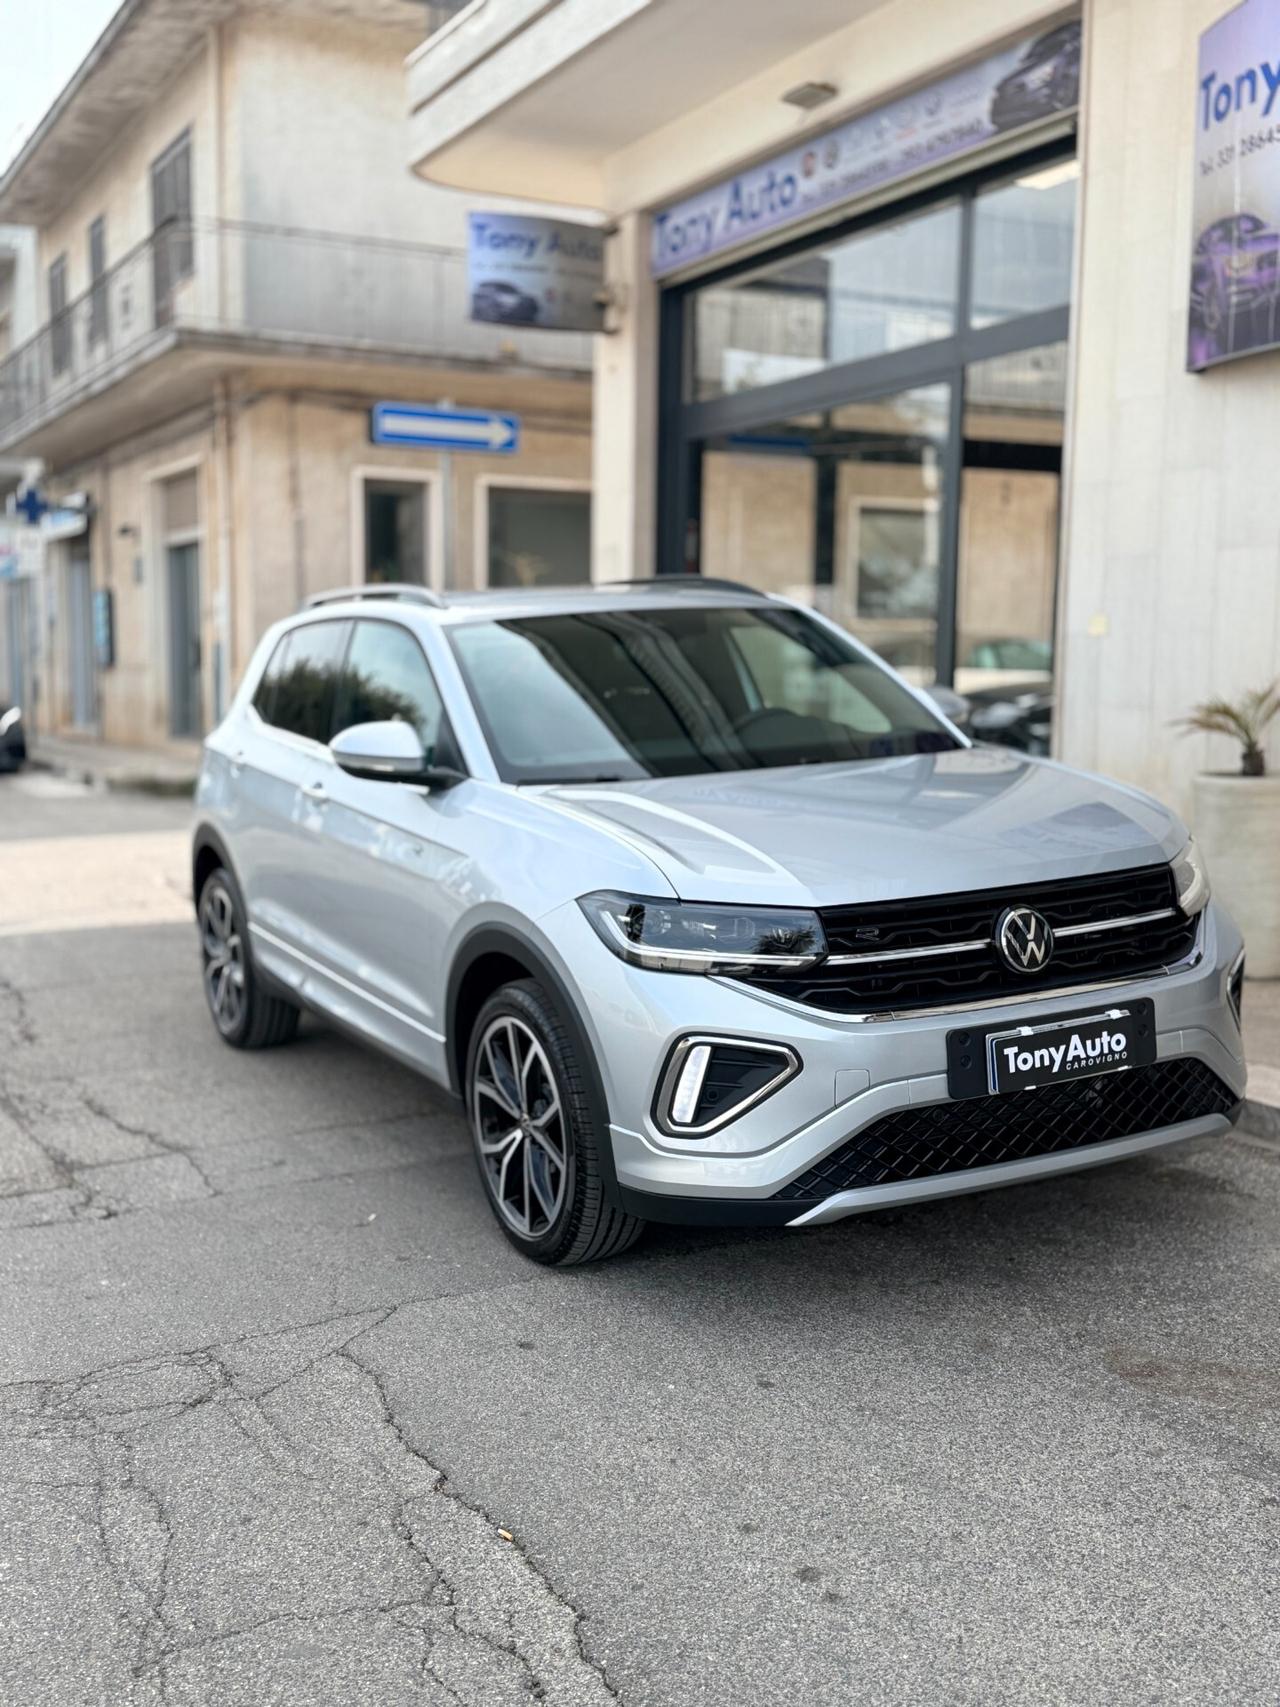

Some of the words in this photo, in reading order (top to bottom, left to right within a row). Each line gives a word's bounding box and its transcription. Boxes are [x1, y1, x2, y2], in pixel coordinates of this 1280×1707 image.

[1201, 61, 1280, 131] Tony
[473, 222, 541, 259] Tony
[654, 205, 718, 261] Tony
[723, 171, 797, 232] Auto
[1065, 1051, 1128, 1071] CAROVIGNO
